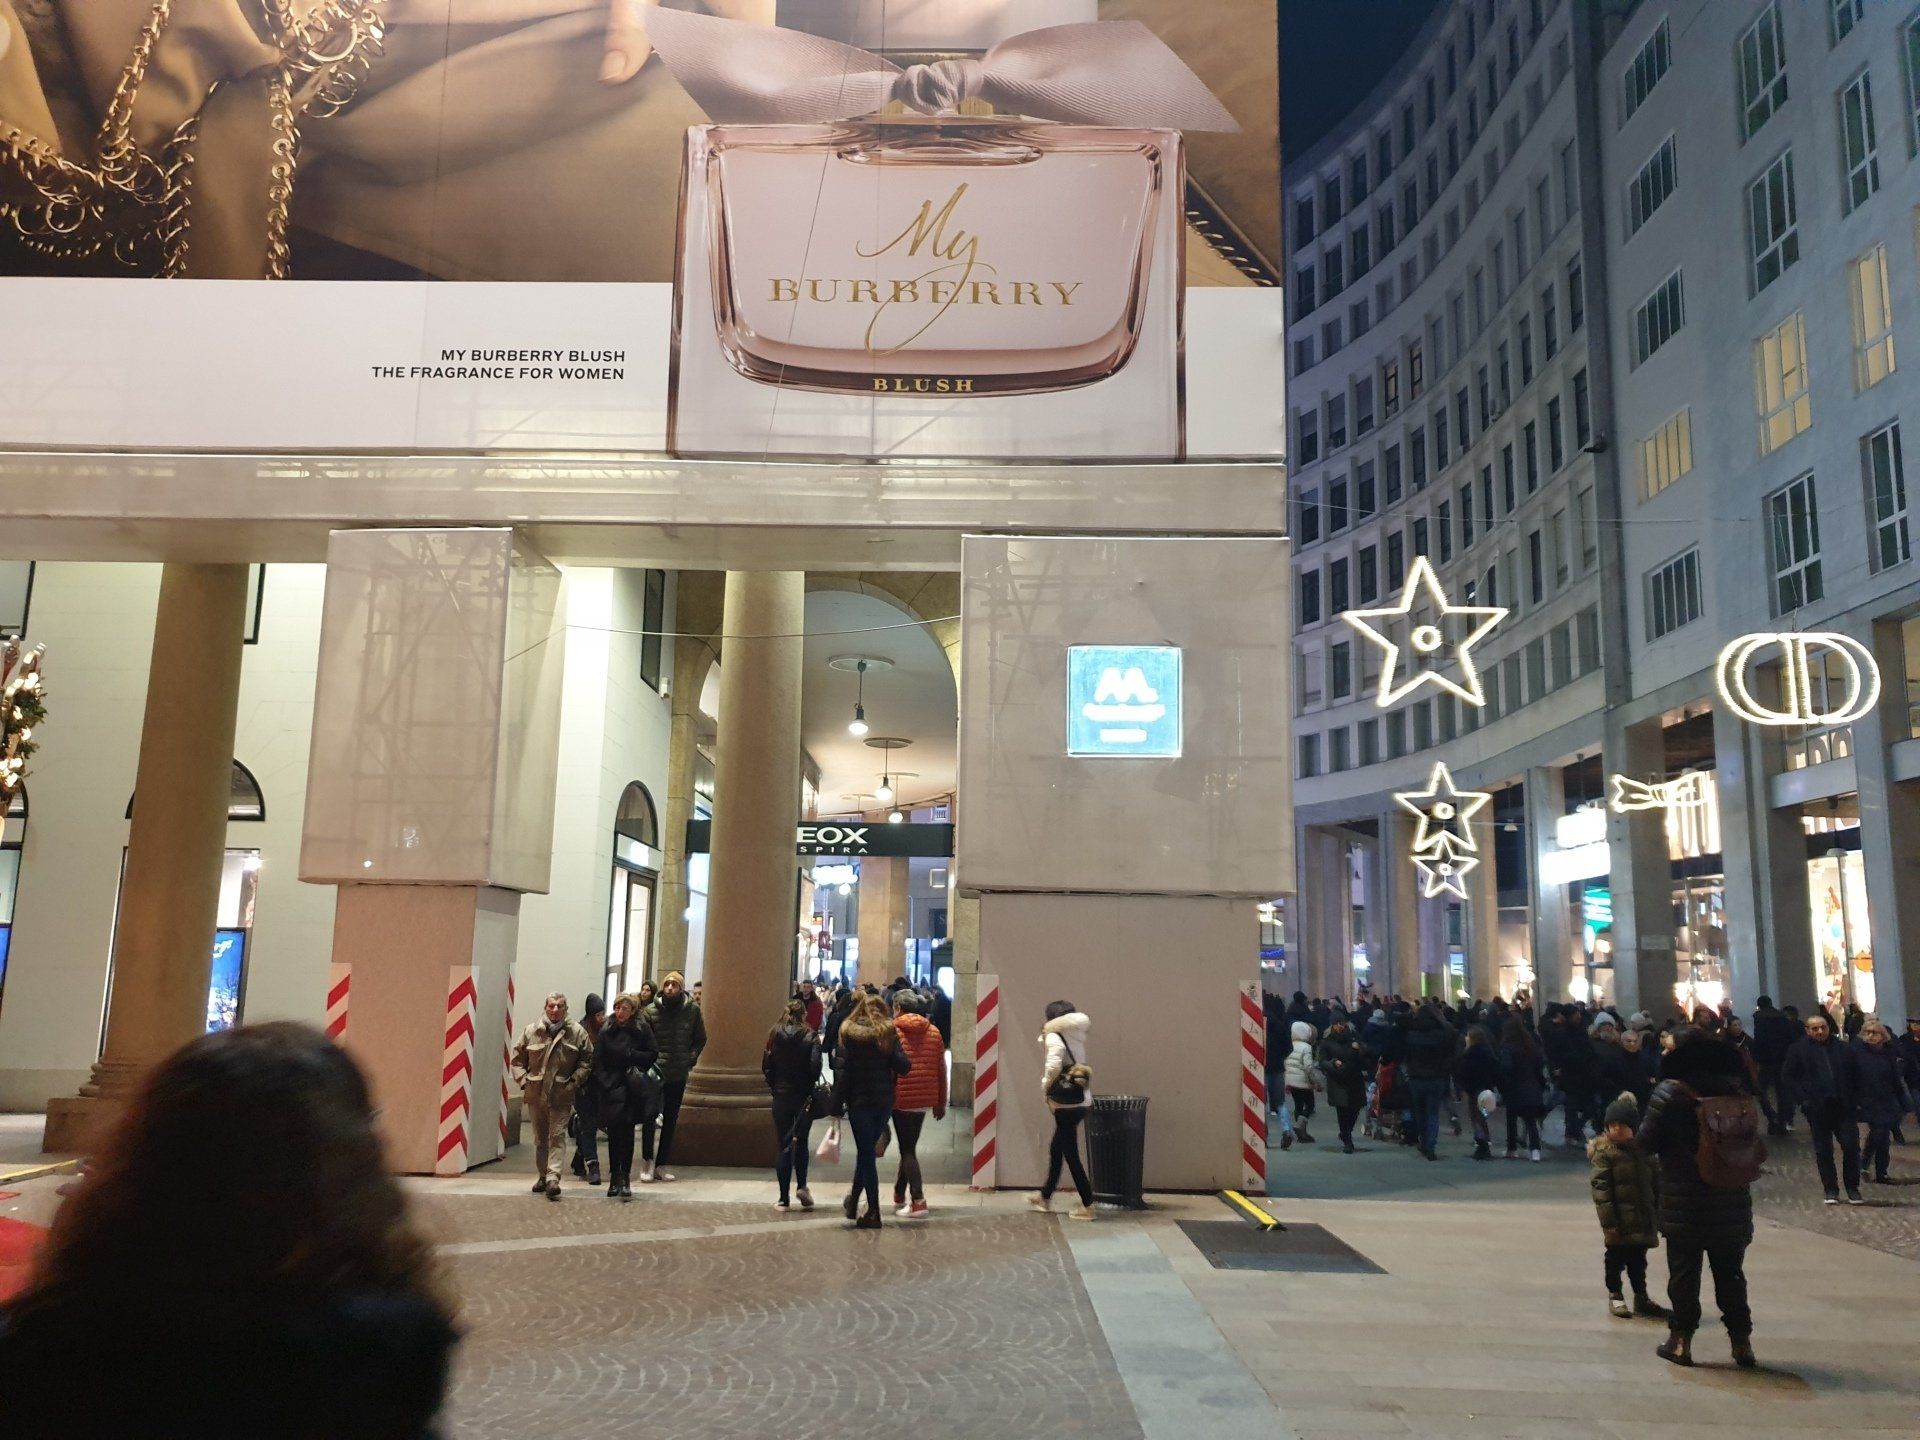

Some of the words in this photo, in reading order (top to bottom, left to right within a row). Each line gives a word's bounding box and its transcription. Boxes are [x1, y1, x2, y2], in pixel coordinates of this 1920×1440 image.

[769, 278, 1083, 305] BURBERRY
[441, 349, 467, 361] MY
[471, 350, 564, 362] BURBERRY
[568, 350, 626, 362] BLUSH
[371, 366, 406, 378] THE
[410, 367, 515, 379] FRAGRANCE
[519, 368, 553, 379] FOR
[558, 368, 625, 380] WOMEN
[874, 378, 974, 393] BLUSH
